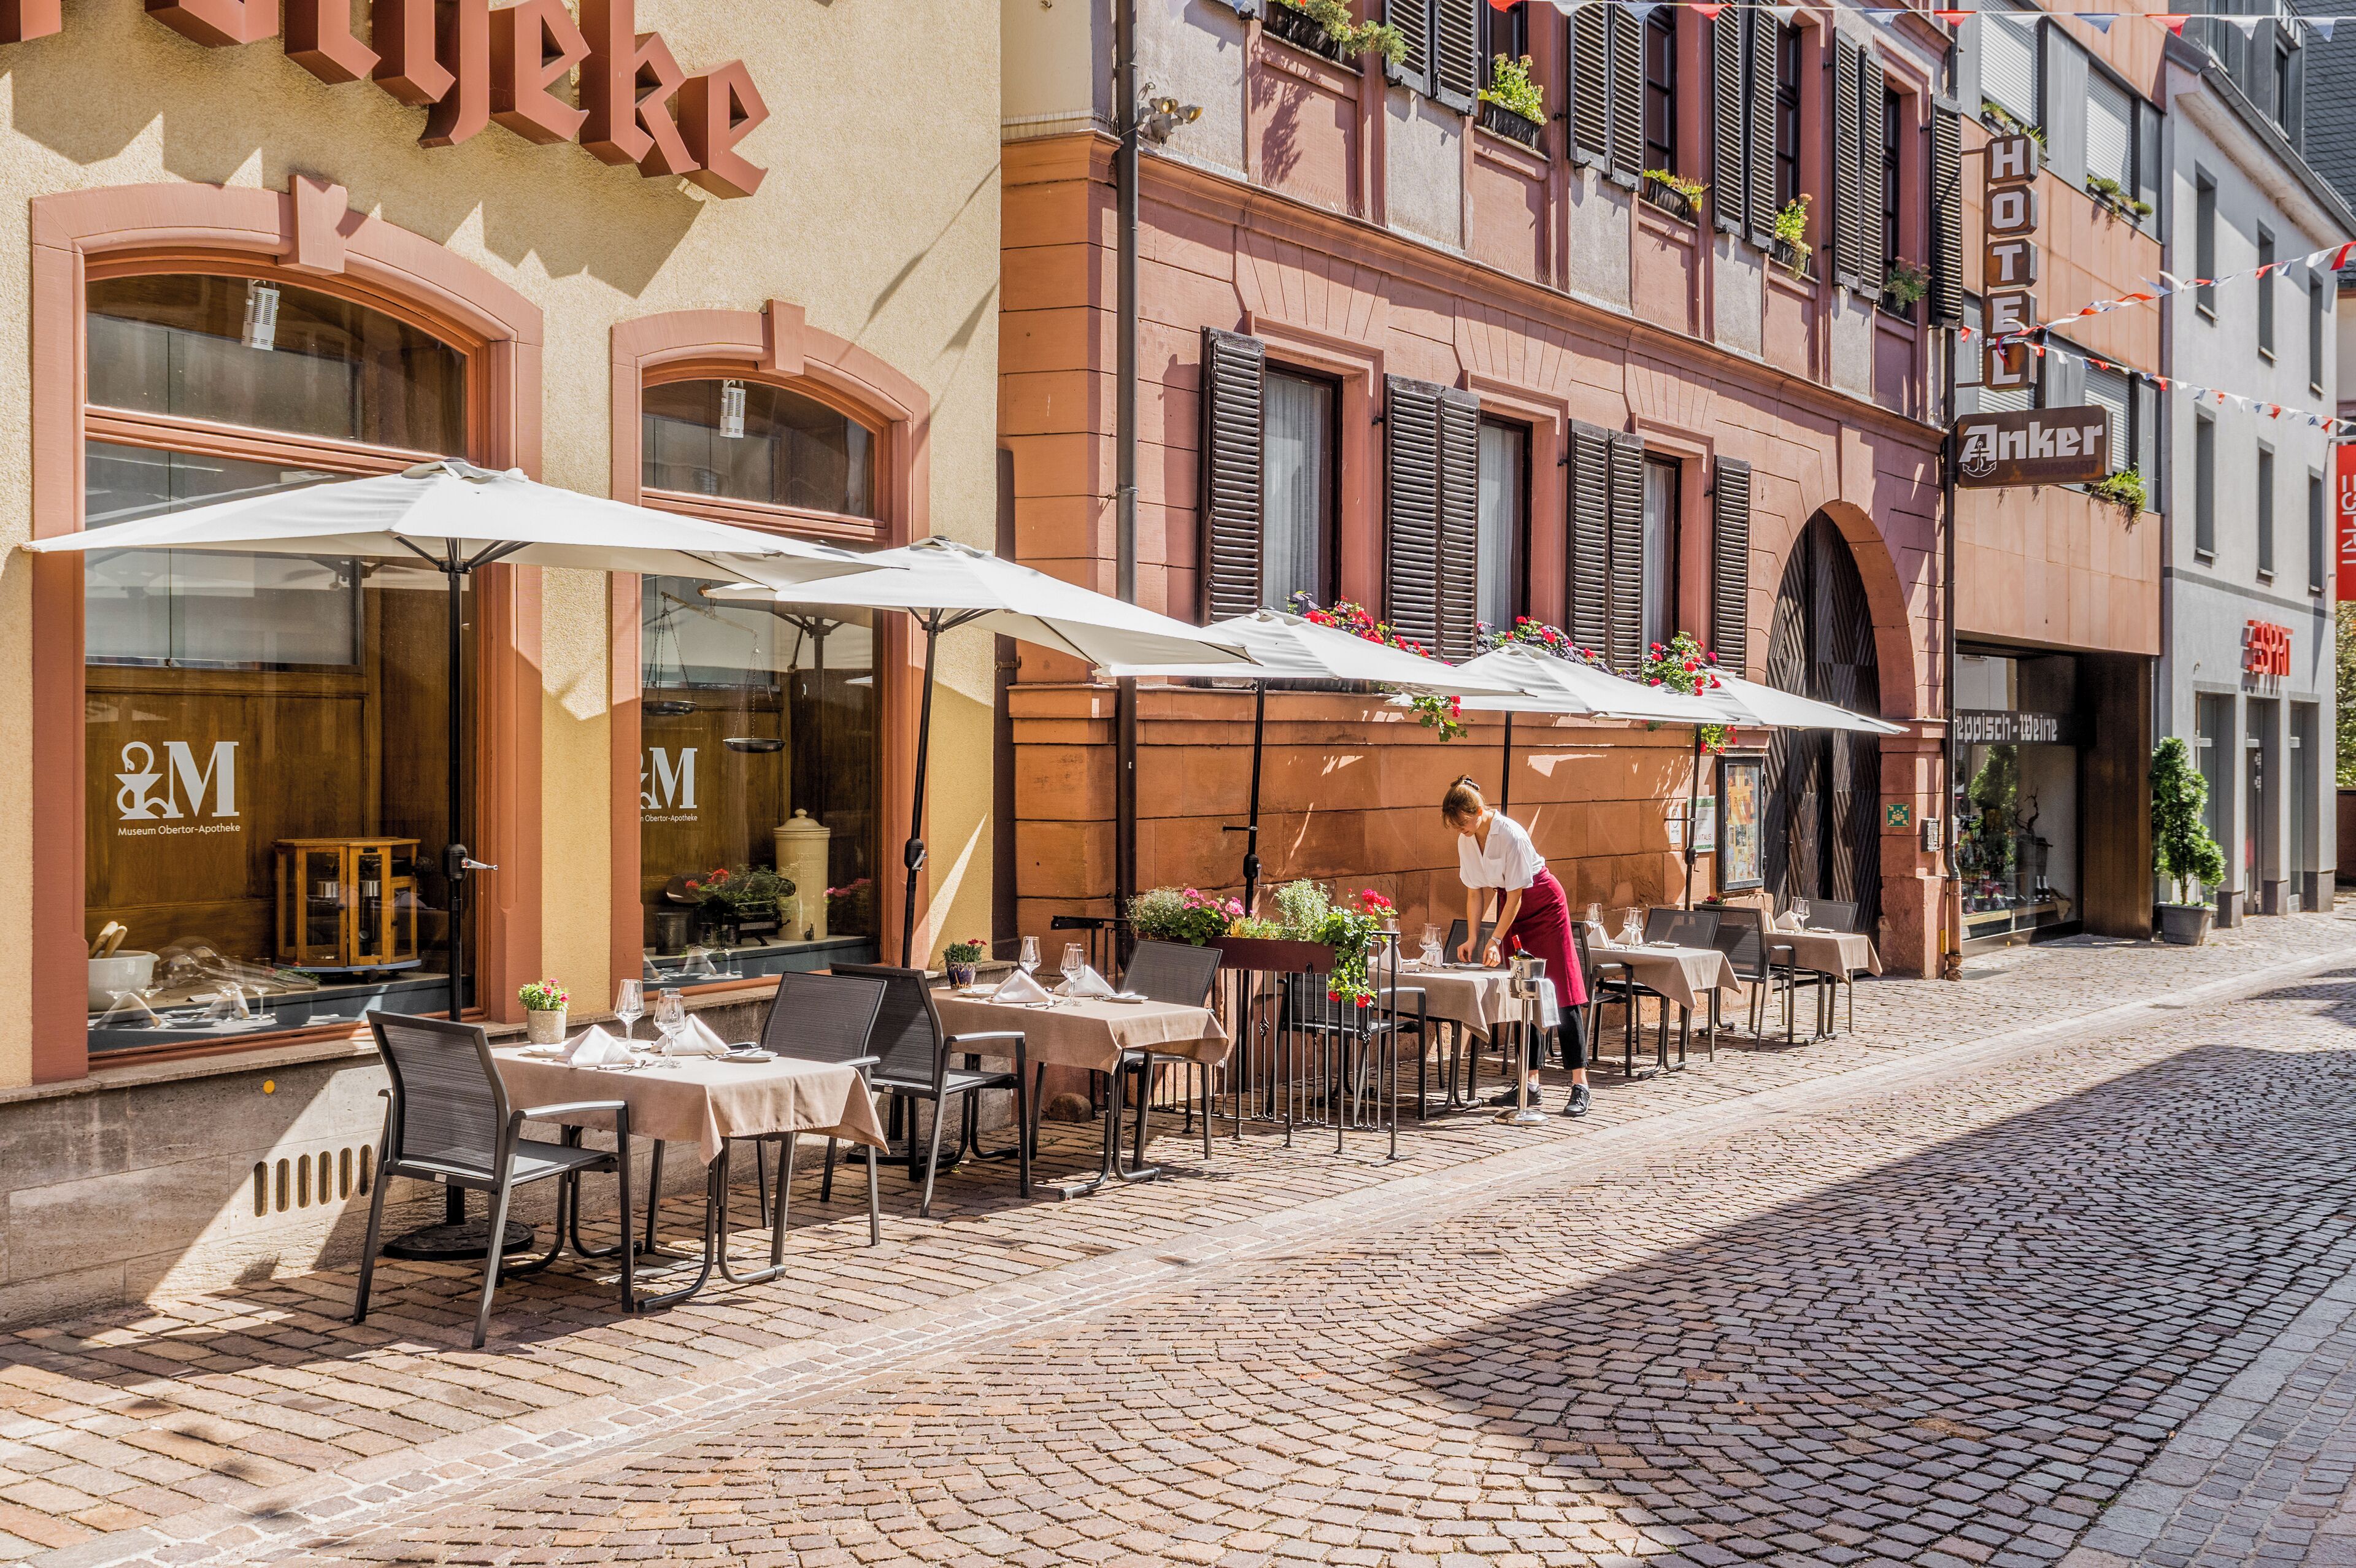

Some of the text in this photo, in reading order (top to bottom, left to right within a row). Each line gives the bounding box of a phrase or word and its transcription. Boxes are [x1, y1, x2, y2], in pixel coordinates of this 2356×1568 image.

[1992, 139, 2025, 386] HOTEL
[1958, 421, 2103, 463] Anker
[118, 823, 241, 836] Museum Obertor-Apotheke
[645, 813, 698, 823] Obertor-Apotheke
